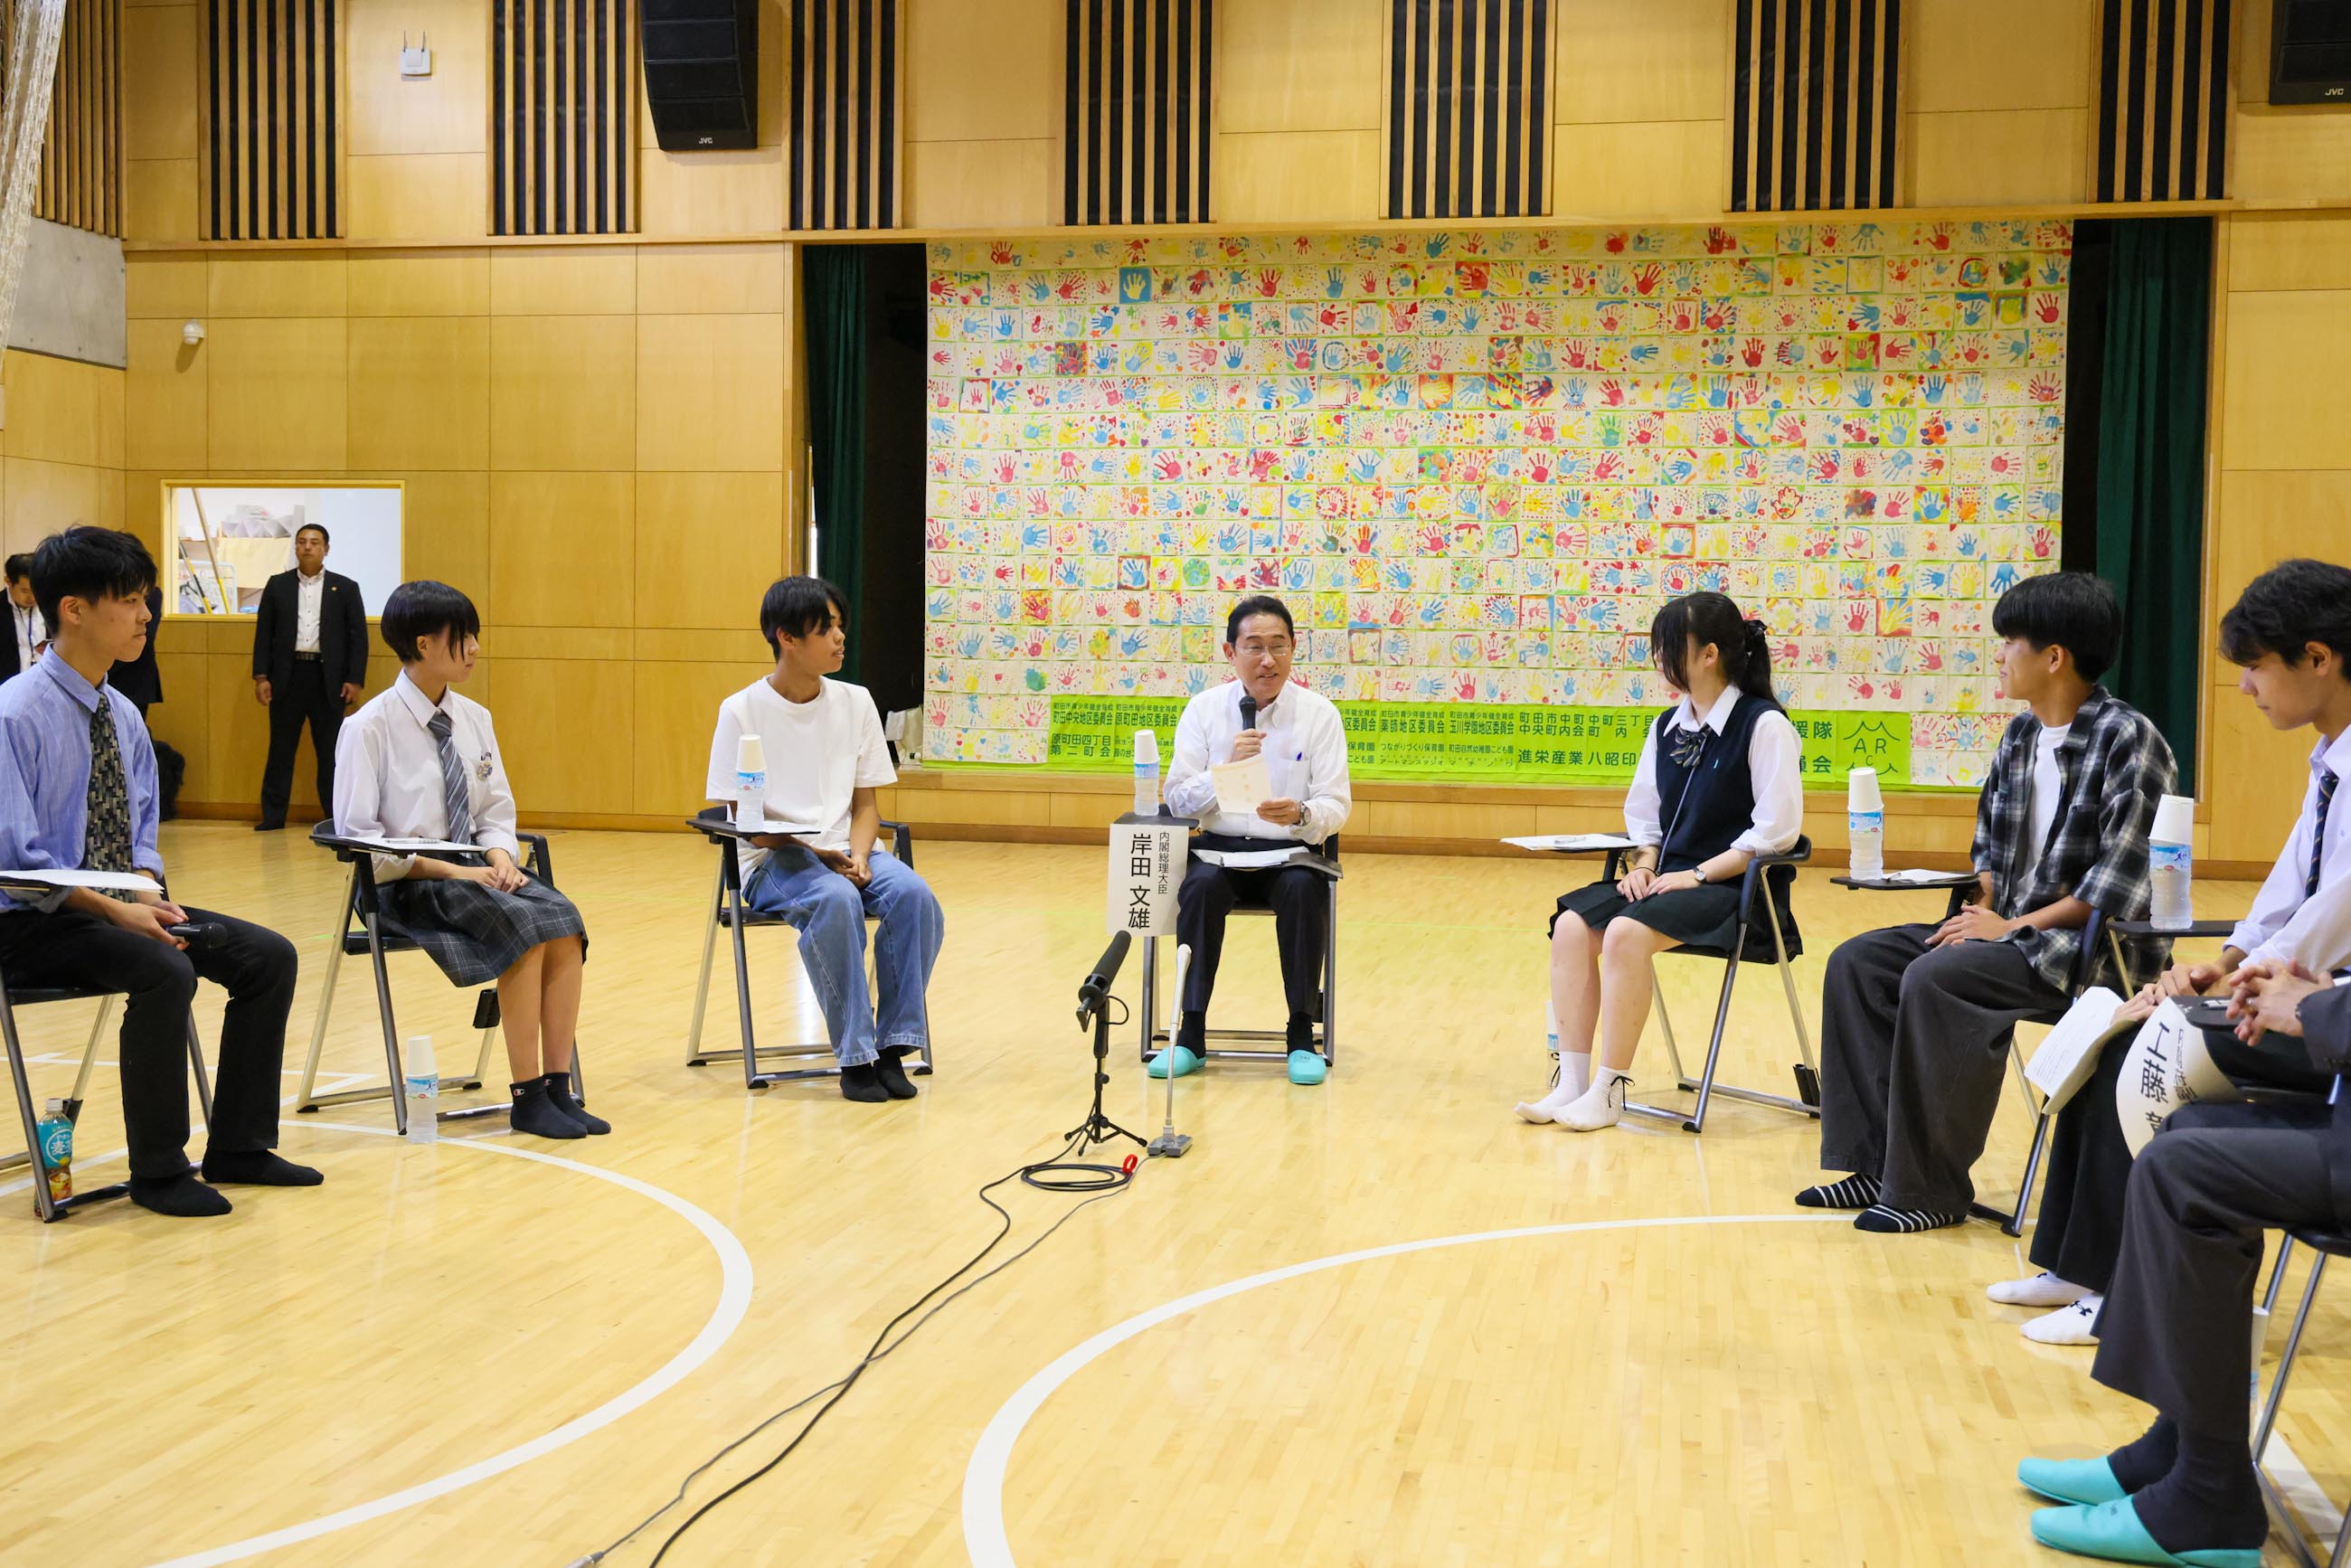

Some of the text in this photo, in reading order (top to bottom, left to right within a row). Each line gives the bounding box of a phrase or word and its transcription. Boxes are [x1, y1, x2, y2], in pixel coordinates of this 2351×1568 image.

[2325, 88, 2345, 96] JVC
[698, 137, 713, 145] JVC
[1053, 711, 1113, 725] 町田中央地区委員会
[1116, 712, 1177, 727] 原町田地区委員会
[1342, 717, 1376, 732] 区委員会
[1519, 712, 1585, 726] 町田市中町
[1381, 719, 1445, 733] 薬師地区委員会
[1449, 720, 1515, 735] 玉川学園地区委員会
[1519, 723, 1584, 737] 中央町内会
[1051, 732, 1111, 746] 原町田四丁目
[1050, 744, 1110, 757] 第二町会
[1381, 743, 1445, 753] つながりづくり保育園
[1518, 749, 1583, 766] 進栄産業
[1588, 751, 1642, 767] 八昭印
[1157, 831, 1170, 894] 内閣総理大臣
[1128, 833, 1152, 930] 岸田 文雄
